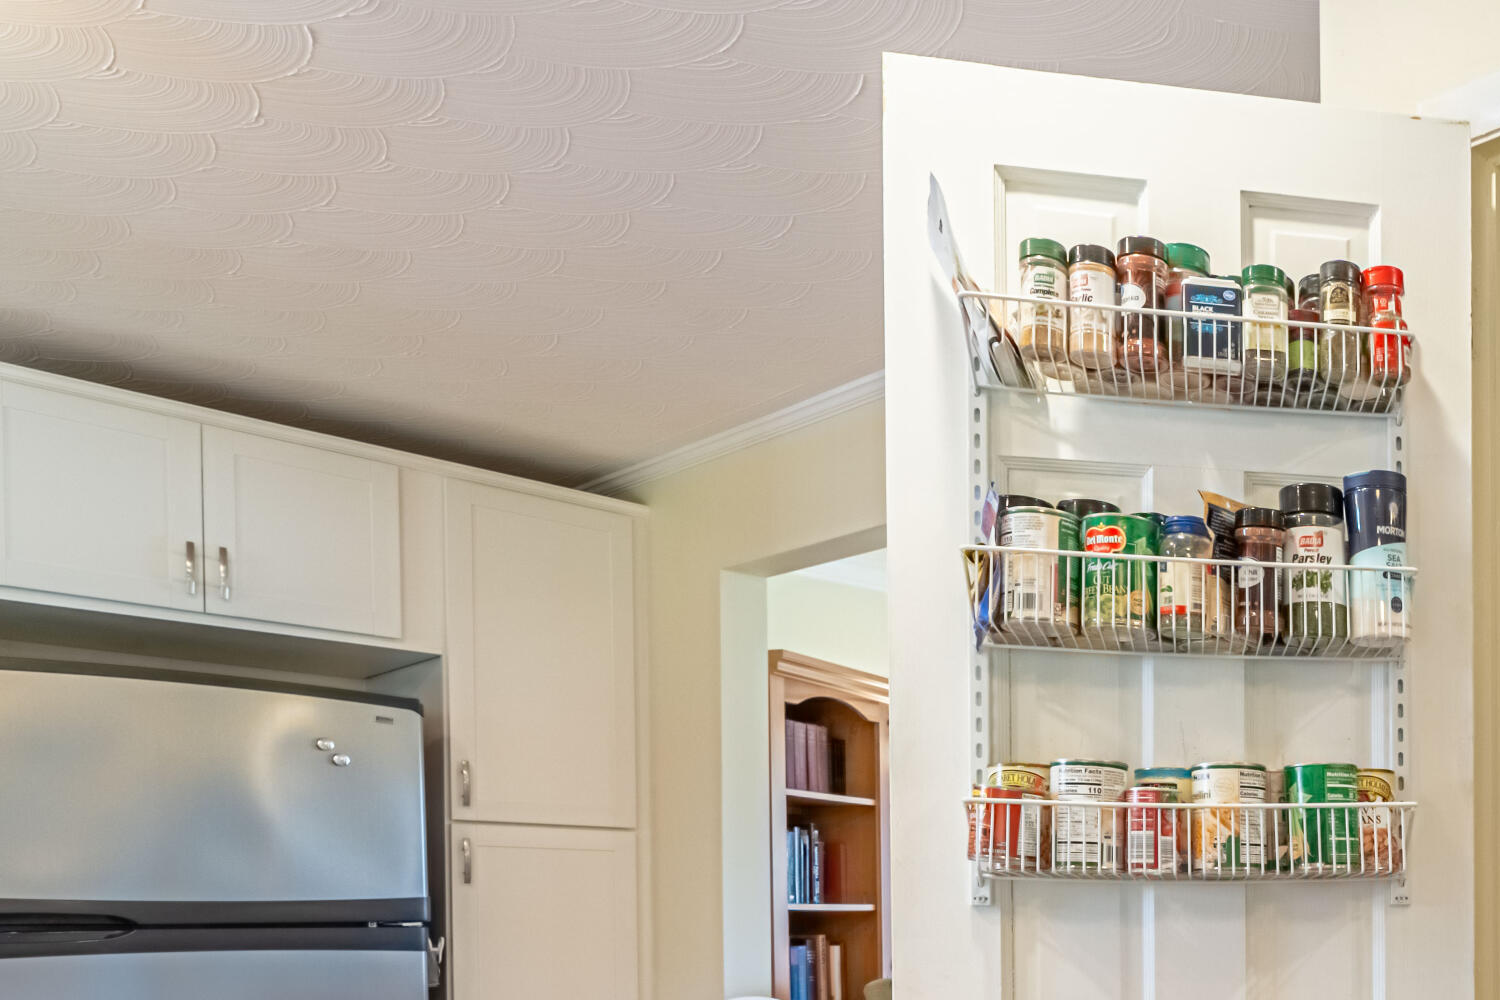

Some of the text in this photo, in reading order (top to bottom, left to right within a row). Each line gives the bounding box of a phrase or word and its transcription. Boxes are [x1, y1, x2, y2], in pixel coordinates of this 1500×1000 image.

[1192, 305, 1213, 313] BLACK
[1096, 535, 1122, 545] Monte
[1300, 536, 1322, 545] BADIA
[1292, 554, 1332, 564] Parsley
[1388, 554, 1400, 562] SEA
[1103, 585, 1128, 594] BEAN
